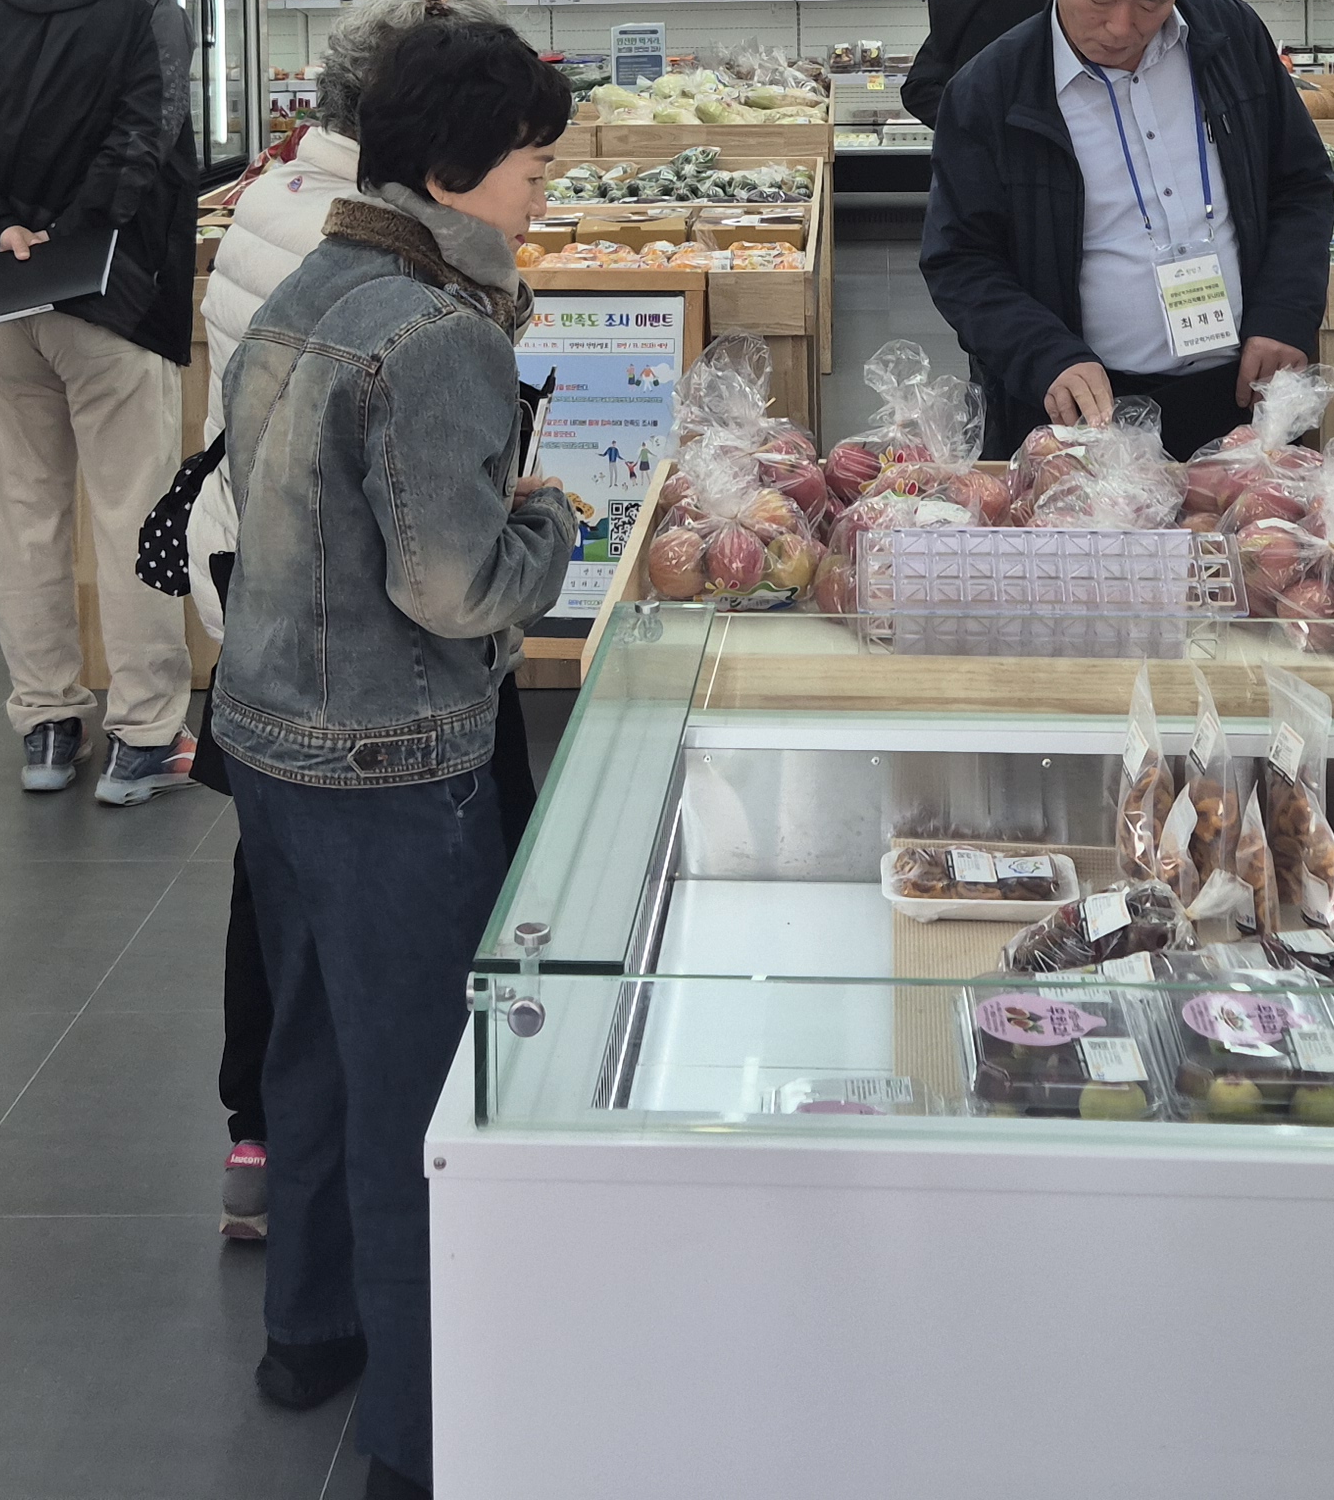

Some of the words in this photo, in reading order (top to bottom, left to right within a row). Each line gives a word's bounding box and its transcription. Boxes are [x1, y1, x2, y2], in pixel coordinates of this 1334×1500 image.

[560, 313, 600, 328] 만족도
[604, 313, 631, 328] 조사
[635, 313, 674, 328] 이벤트
